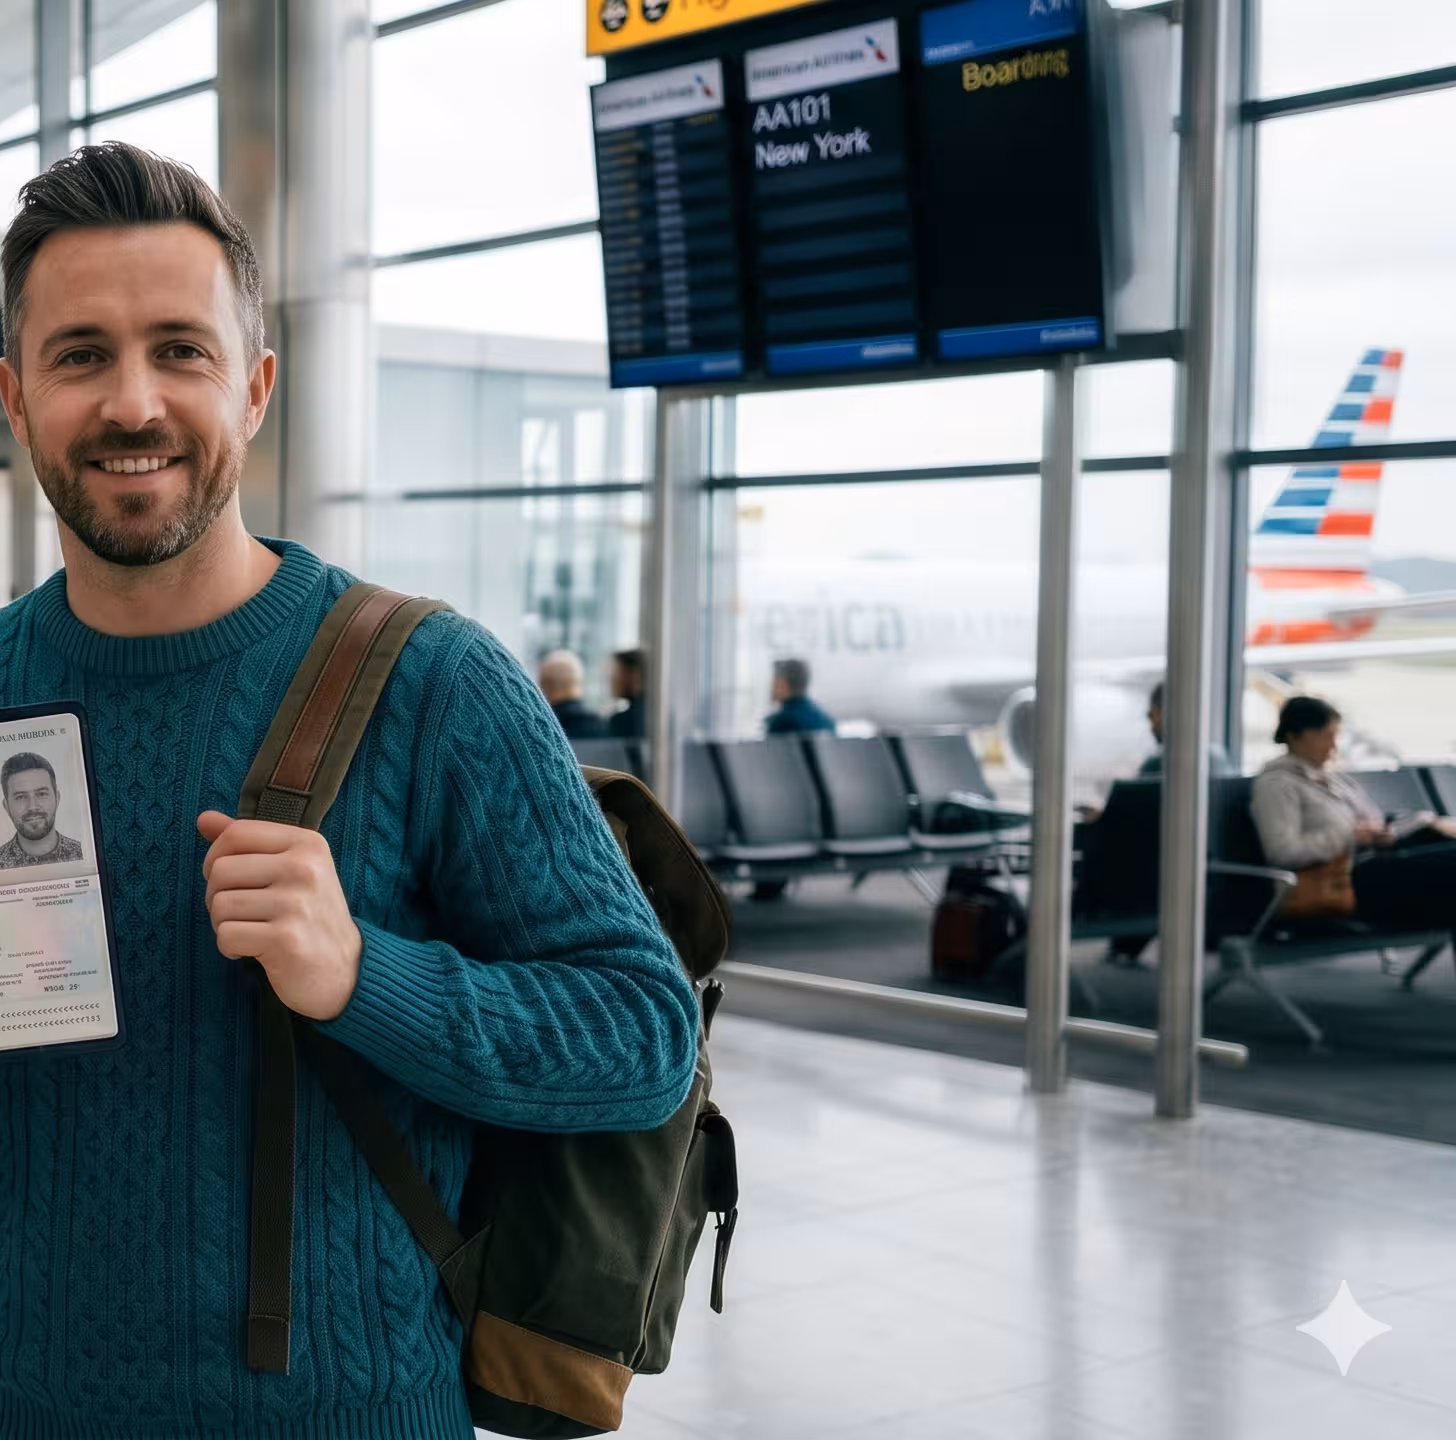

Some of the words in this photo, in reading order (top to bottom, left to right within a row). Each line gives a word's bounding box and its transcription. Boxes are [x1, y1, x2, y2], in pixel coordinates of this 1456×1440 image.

[752, 93, 831, 133] AA101
[754, 141, 810, 170] New
[813, 126, 872, 160] York
